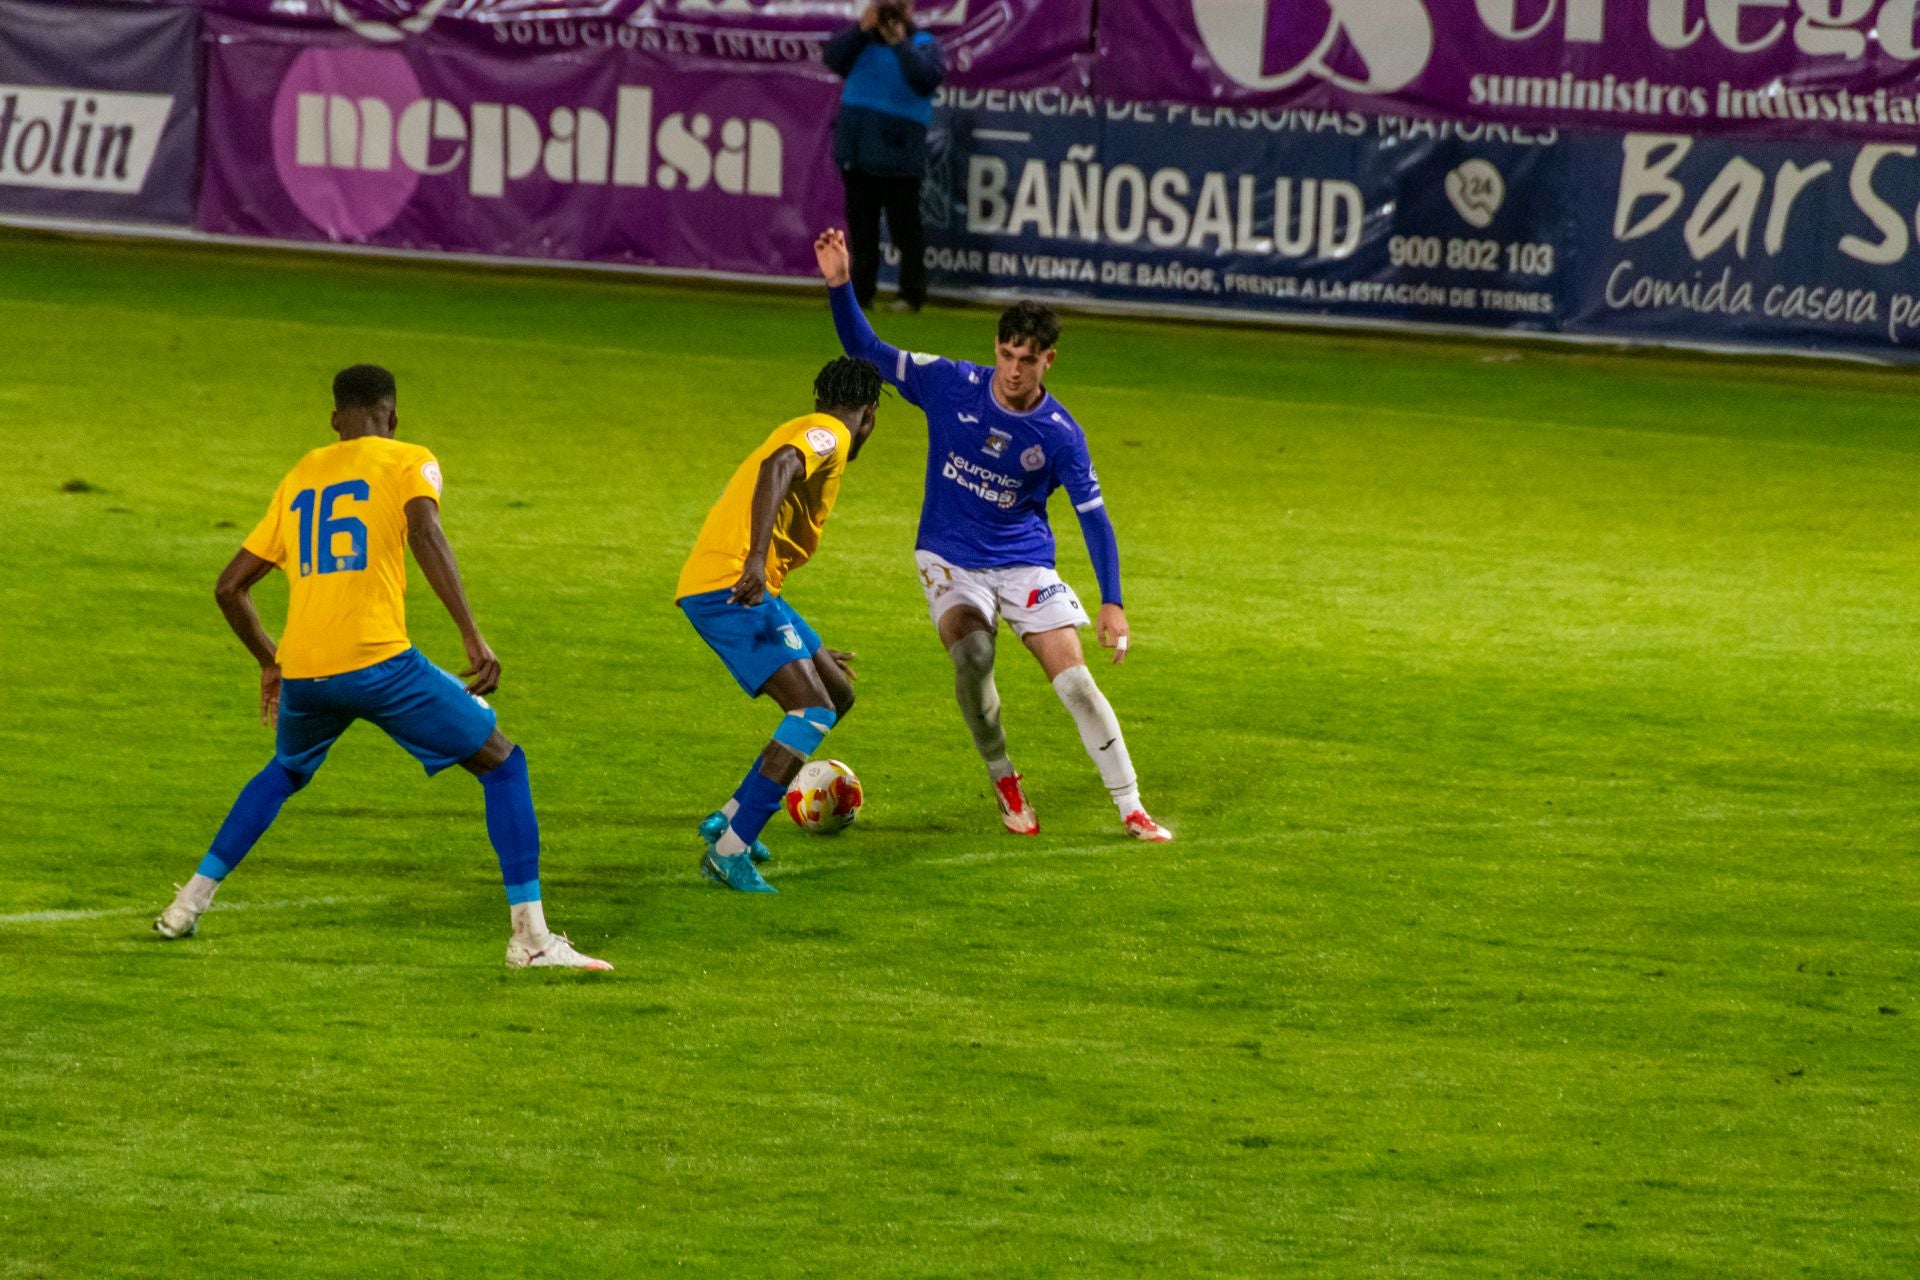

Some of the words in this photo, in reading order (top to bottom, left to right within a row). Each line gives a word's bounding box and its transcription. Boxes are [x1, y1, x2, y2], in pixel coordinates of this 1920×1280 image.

[1469, 72, 1708, 117] suministros
[1717, 81, 1920, 125] industria
[296, 85, 783, 197] mepalsa
[966, 143, 1365, 259] BAÑOSALUD
[1469, 177, 1492, 196] 24
[1614, 132, 1832, 260] Bar
[1838, 143, 1920, 265] S
[988, 249, 1019, 277] EN
[1022, 254, 1096, 282] VENTA
[1101, 260, 1134, 285] DE
[1136, 261, 1220, 294] BAÑOS,
[1224, 272, 1297, 298] FRENTE
[1301, 277, 1316, 297] A
[1319, 278, 1346, 299] LA
[1349, 278, 1443, 306] ESTACIÓN
[1449, 286, 1478, 308] DE
[1480, 288, 1554, 314] TRENES
[1389, 235, 1441, 267] 900
[1446, 238, 1499, 272] 802
[1506, 243, 1554, 275] 103
[1605, 260, 1753, 314] Comida
[1762, 284, 1878, 324] casera
[289, 479, 370, 578] 16
